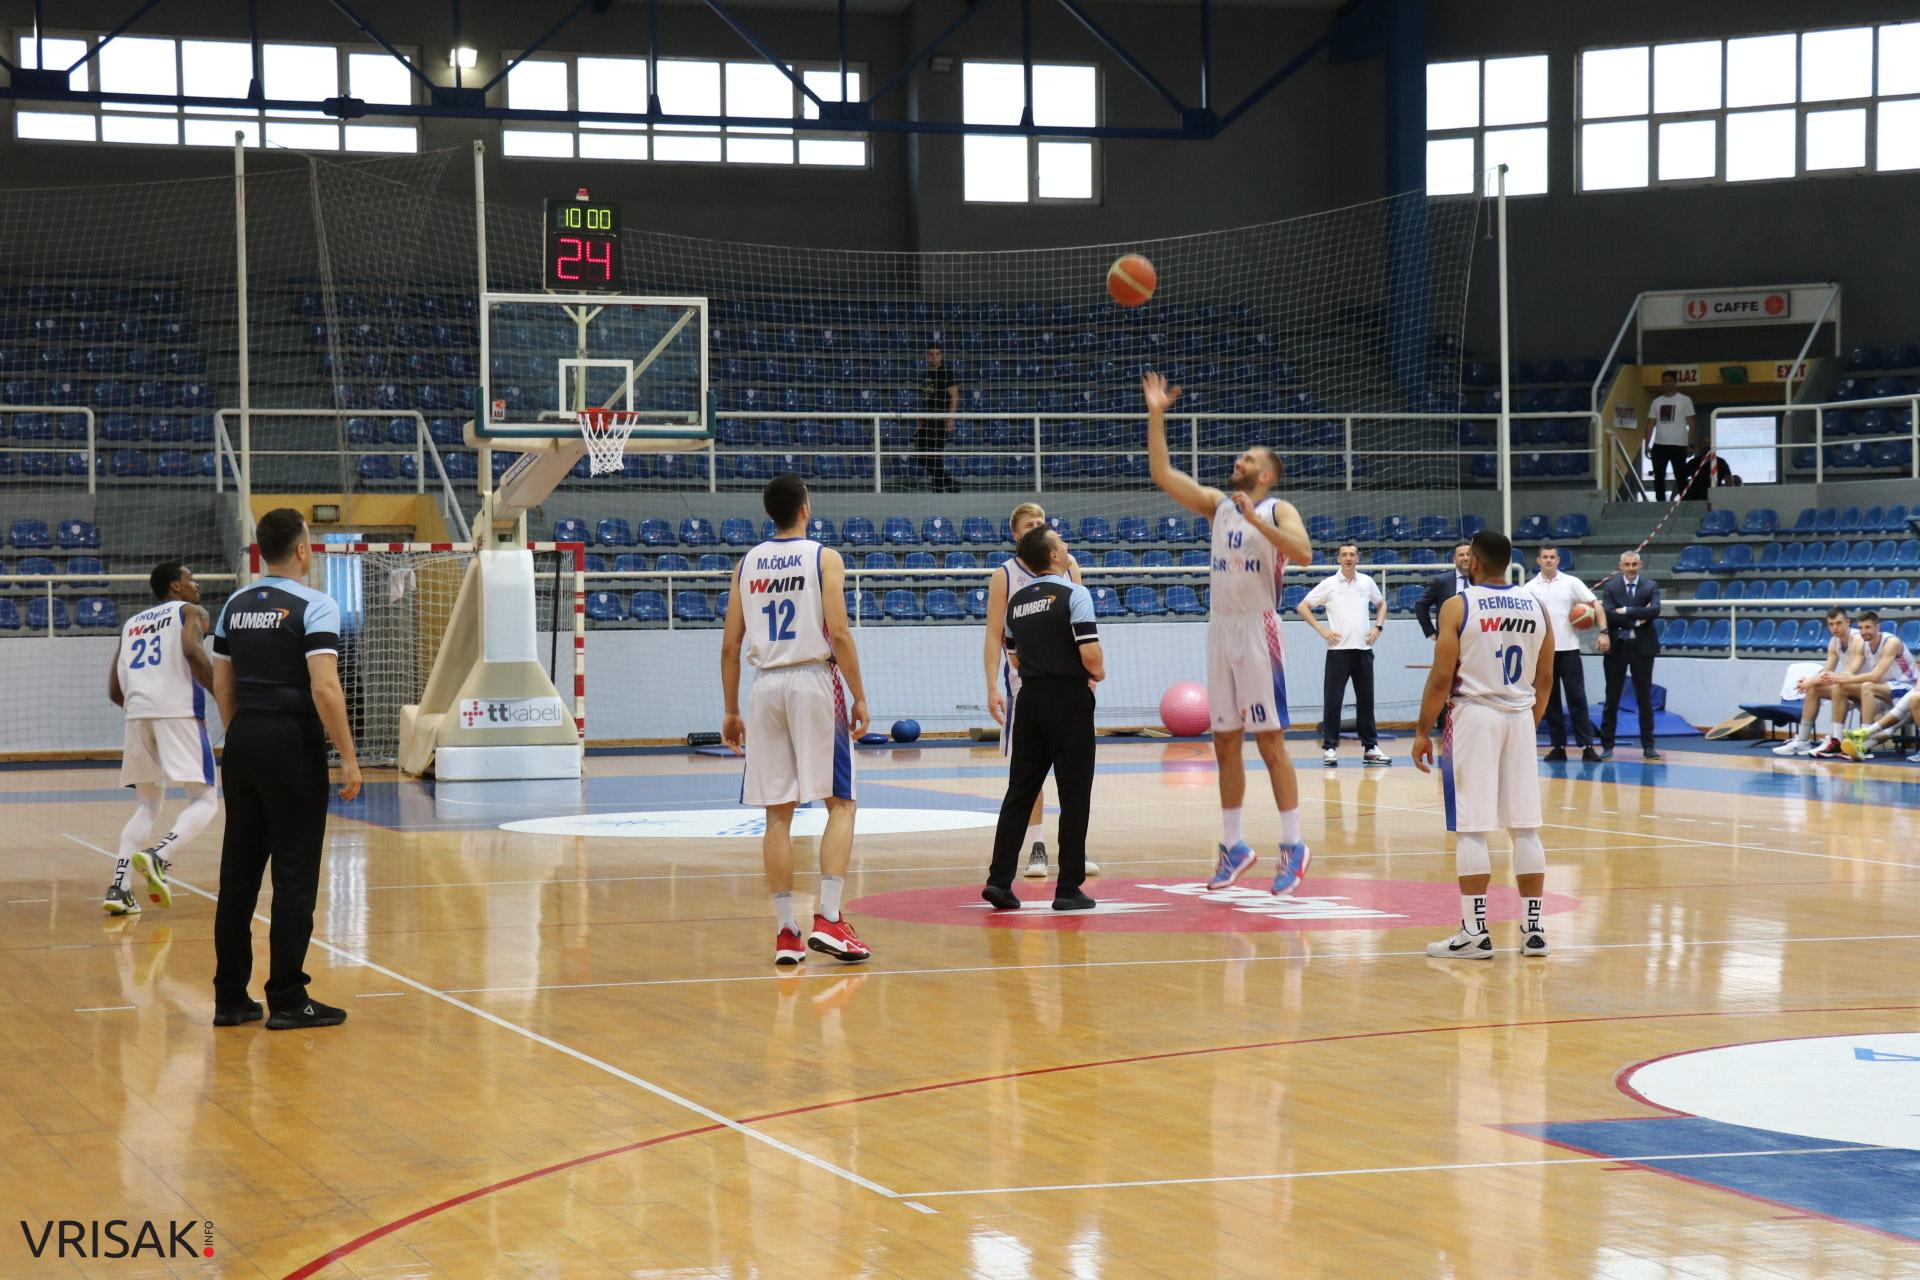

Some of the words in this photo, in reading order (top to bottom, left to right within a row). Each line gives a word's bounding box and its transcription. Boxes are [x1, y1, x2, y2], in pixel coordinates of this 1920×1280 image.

[557, 238, 611, 280] 24
[1713, 301, 1760, 313] CAFFE
[1227, 531, 1243, 549] 19
[757, 555, 802, 570] M.ČOLAK
[1478, 595, 1534, 612] REMBERT
[762, 598, 797, 642] 12
[129, 634, 162, 670] 23
[1495, 643, 1523, 686] 10
[487, 703, 562, 723] ttkabeli
[1250, 702, 1267, 724] 19
